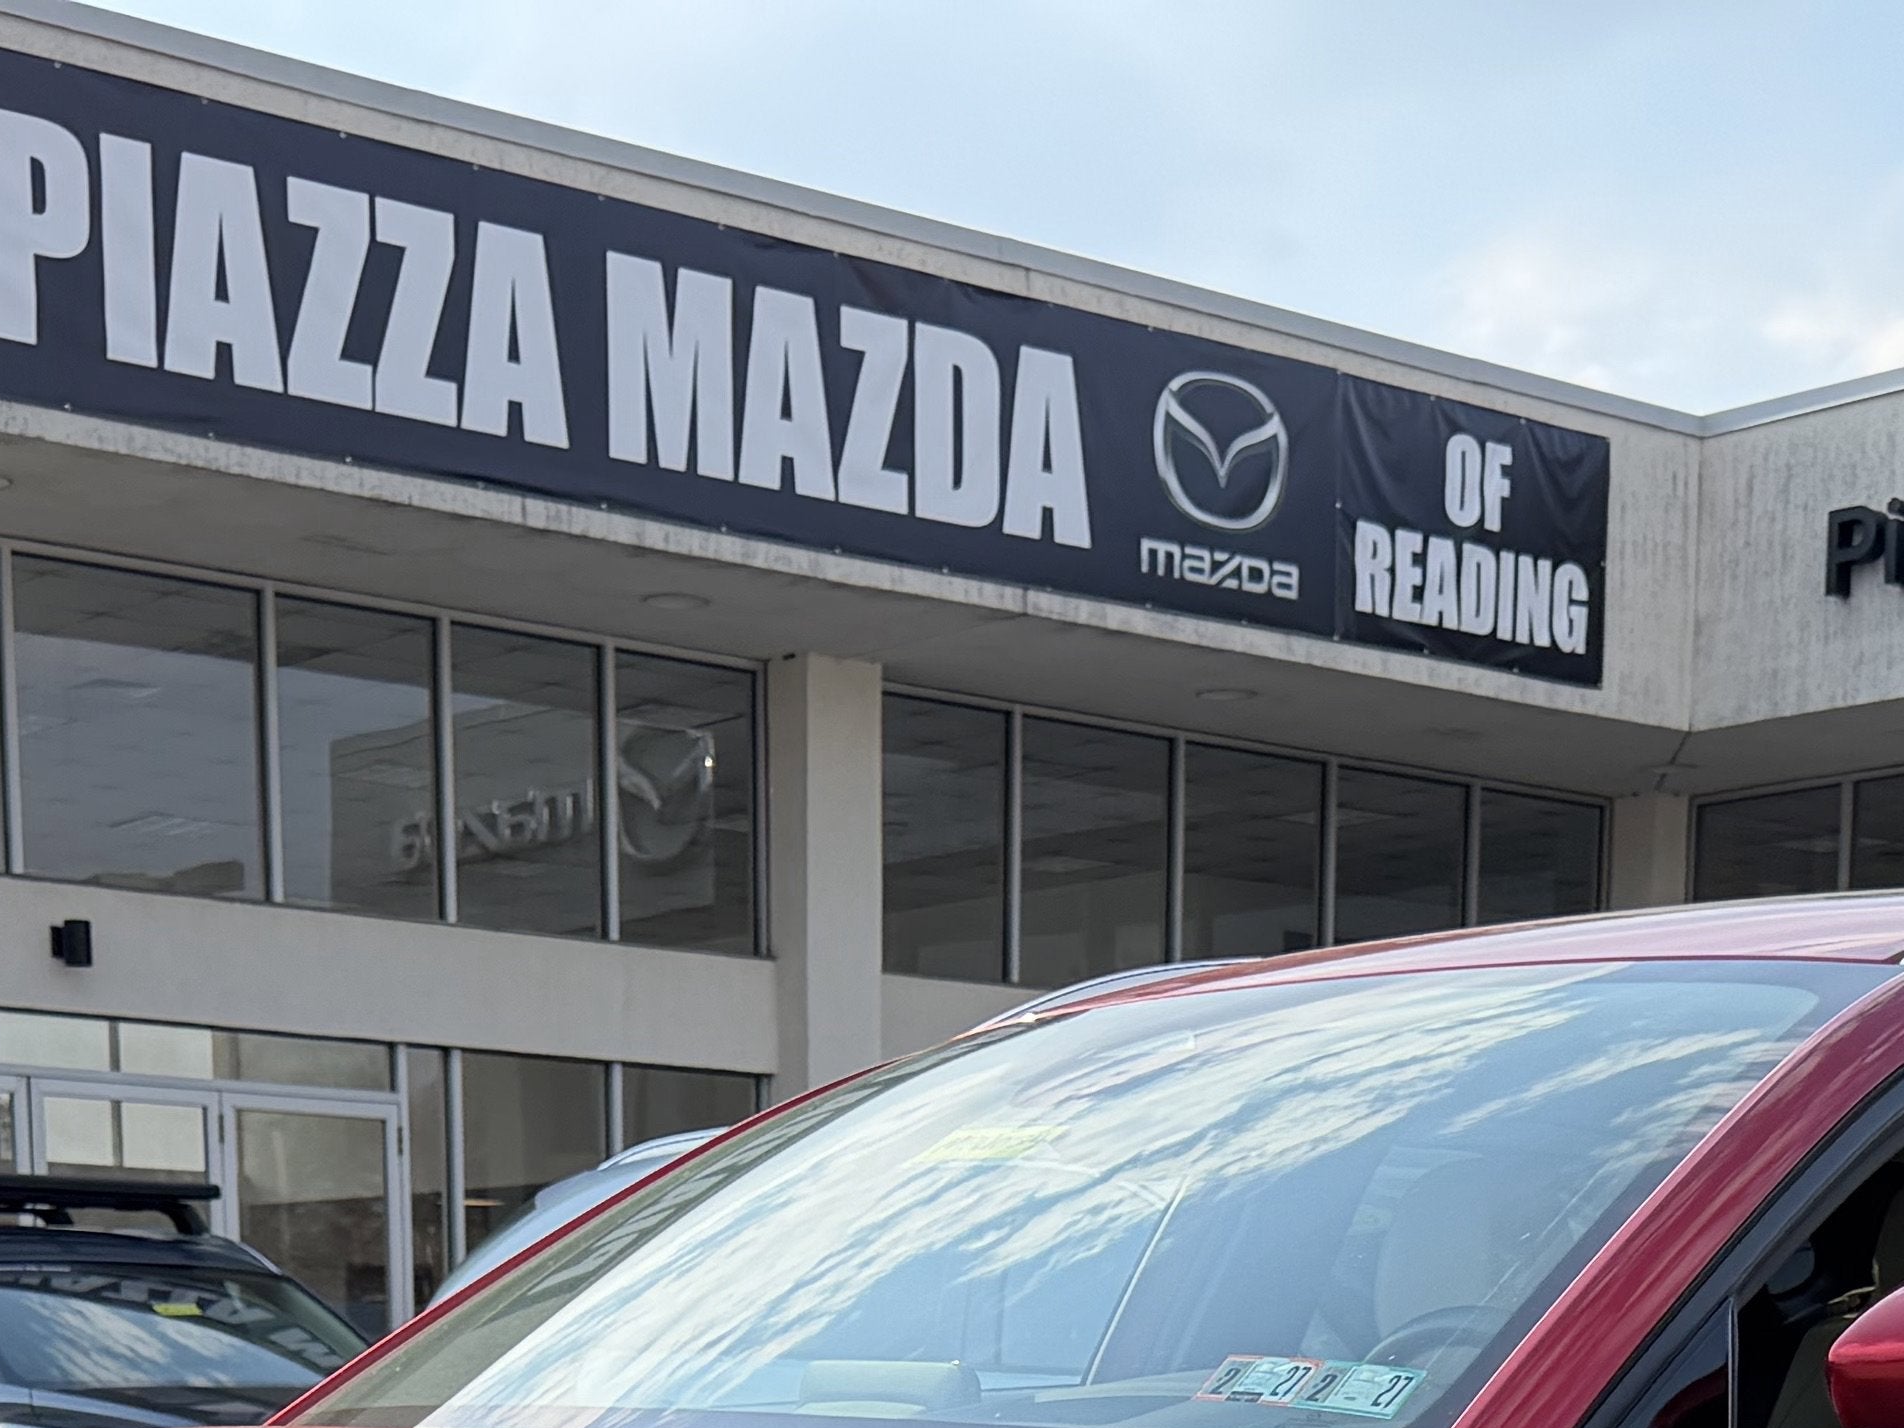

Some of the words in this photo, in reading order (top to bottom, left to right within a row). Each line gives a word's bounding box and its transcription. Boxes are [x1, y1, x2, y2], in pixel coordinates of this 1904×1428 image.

[605, 252, 1092, 550] MAZDA
[1445, 431, 1514, 540] OF
[1140, 537, 1300, 601] mazda
[1353, 518, 1591, 656] READING
[1269, 1365, 1313, 1401] 27
[1370, 1374, 1415, 1409] 27
